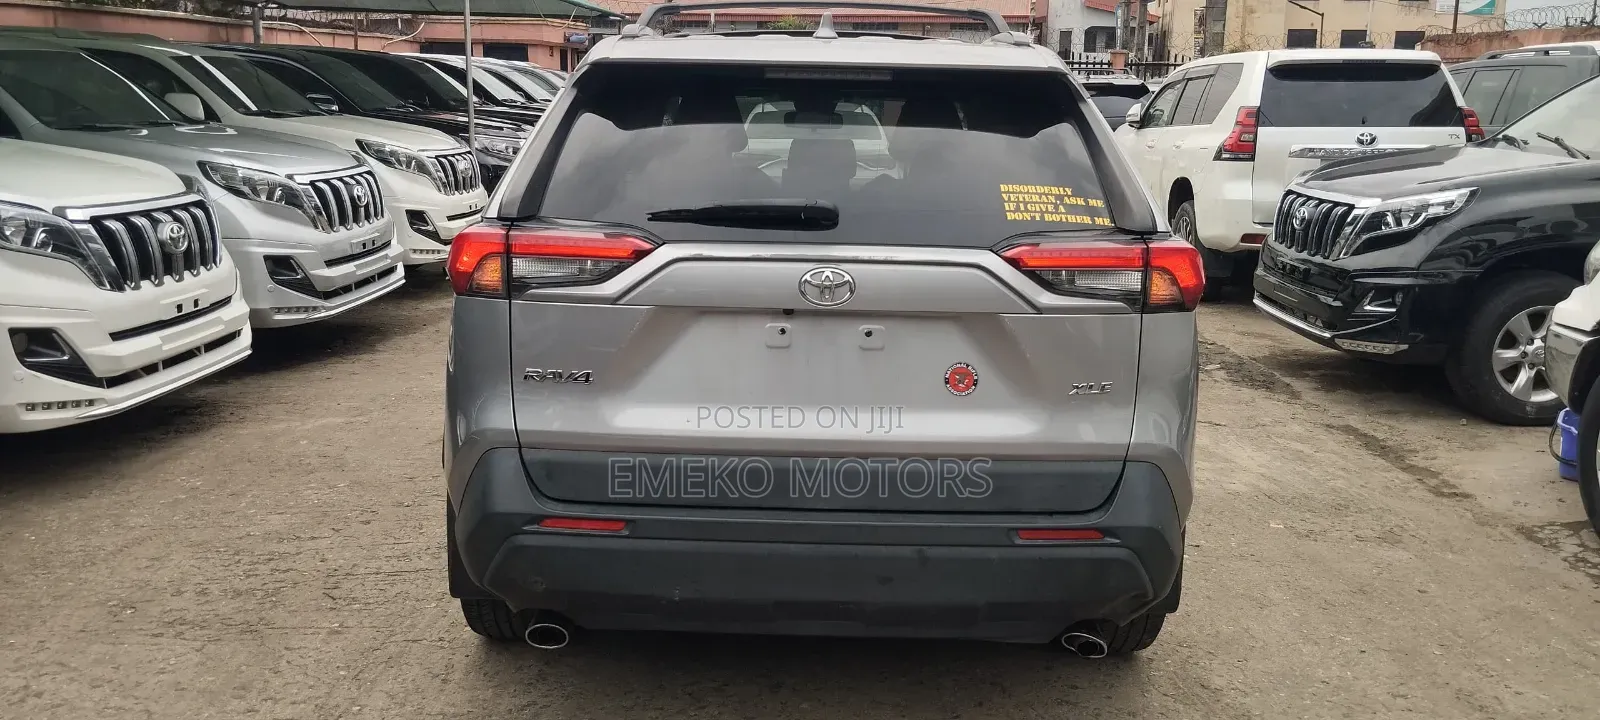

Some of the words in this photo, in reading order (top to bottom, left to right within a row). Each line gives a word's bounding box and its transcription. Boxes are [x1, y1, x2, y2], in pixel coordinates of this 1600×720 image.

[1000, 185, 1072, 195] DISORDERLY
[1002, 194, 1060, 204] VETERAN,
[1063, 197, 1085, 205] ASK
[1087, 199, 1104, 207] ME
[1004, 202, 1016, 211] IF
[1028, 203, 1055, 212] GIVE
[1044, 214, 1092, 223] BOTHER
[524, 368, 593, 385] RAV4
[945, 363, 967, 379] NATIONAL
[968, 365, 978, 379] RIFLE
[945, 384, 976, 396] ASSOCIATION
[1069, 382, 1112, 395] XLE
